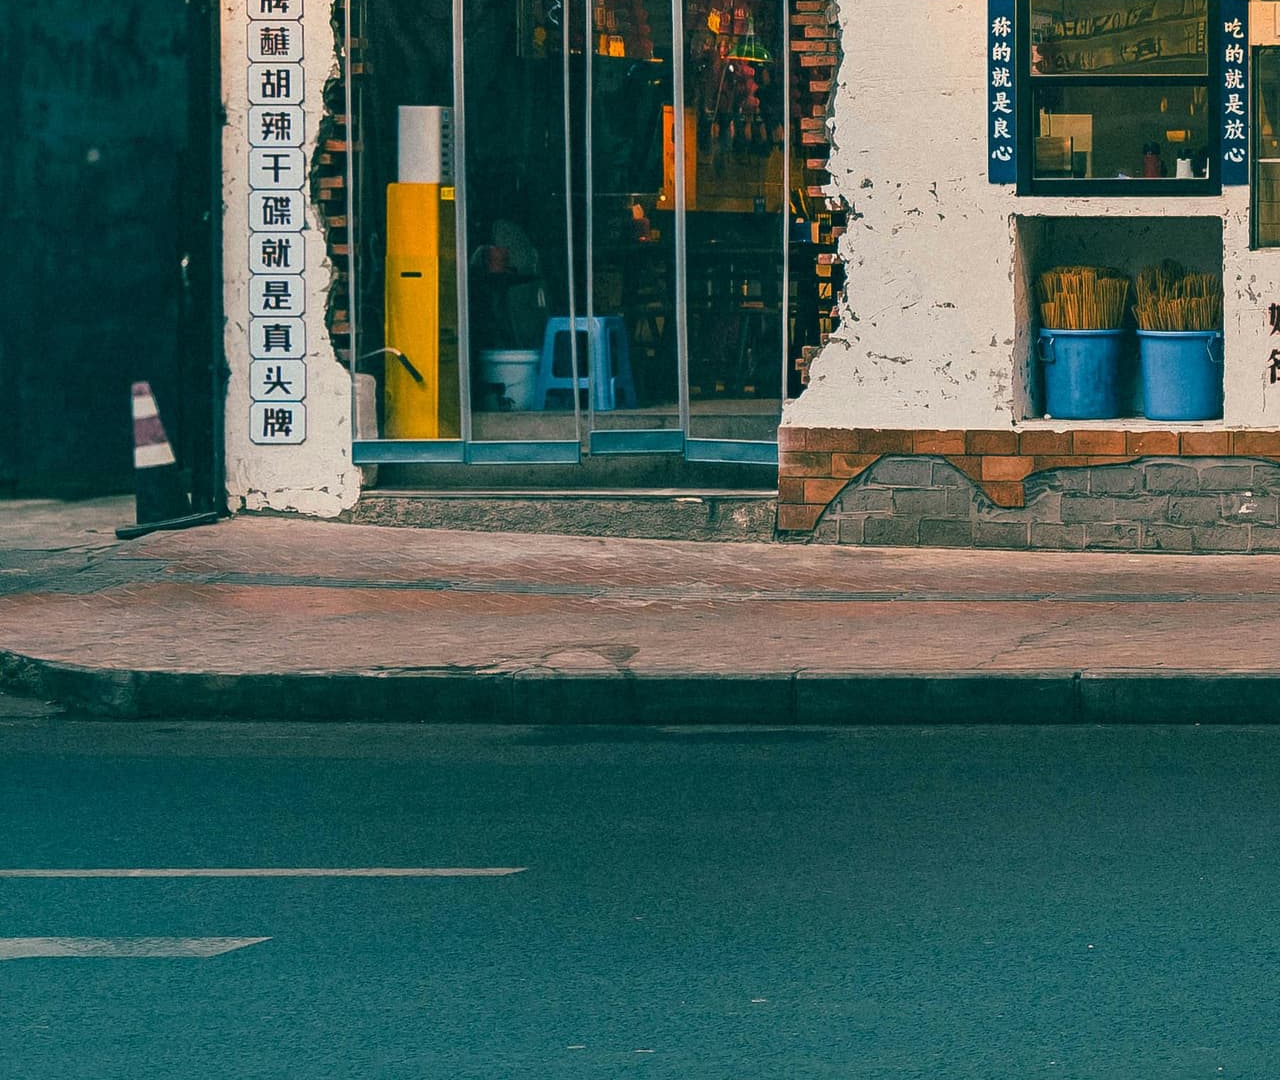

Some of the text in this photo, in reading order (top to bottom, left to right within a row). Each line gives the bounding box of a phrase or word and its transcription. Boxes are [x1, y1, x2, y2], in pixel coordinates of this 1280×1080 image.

[991, 16, 1012, 163] 称的就是良心
[1223, 18, 1245, 164] 吃的就是放心
